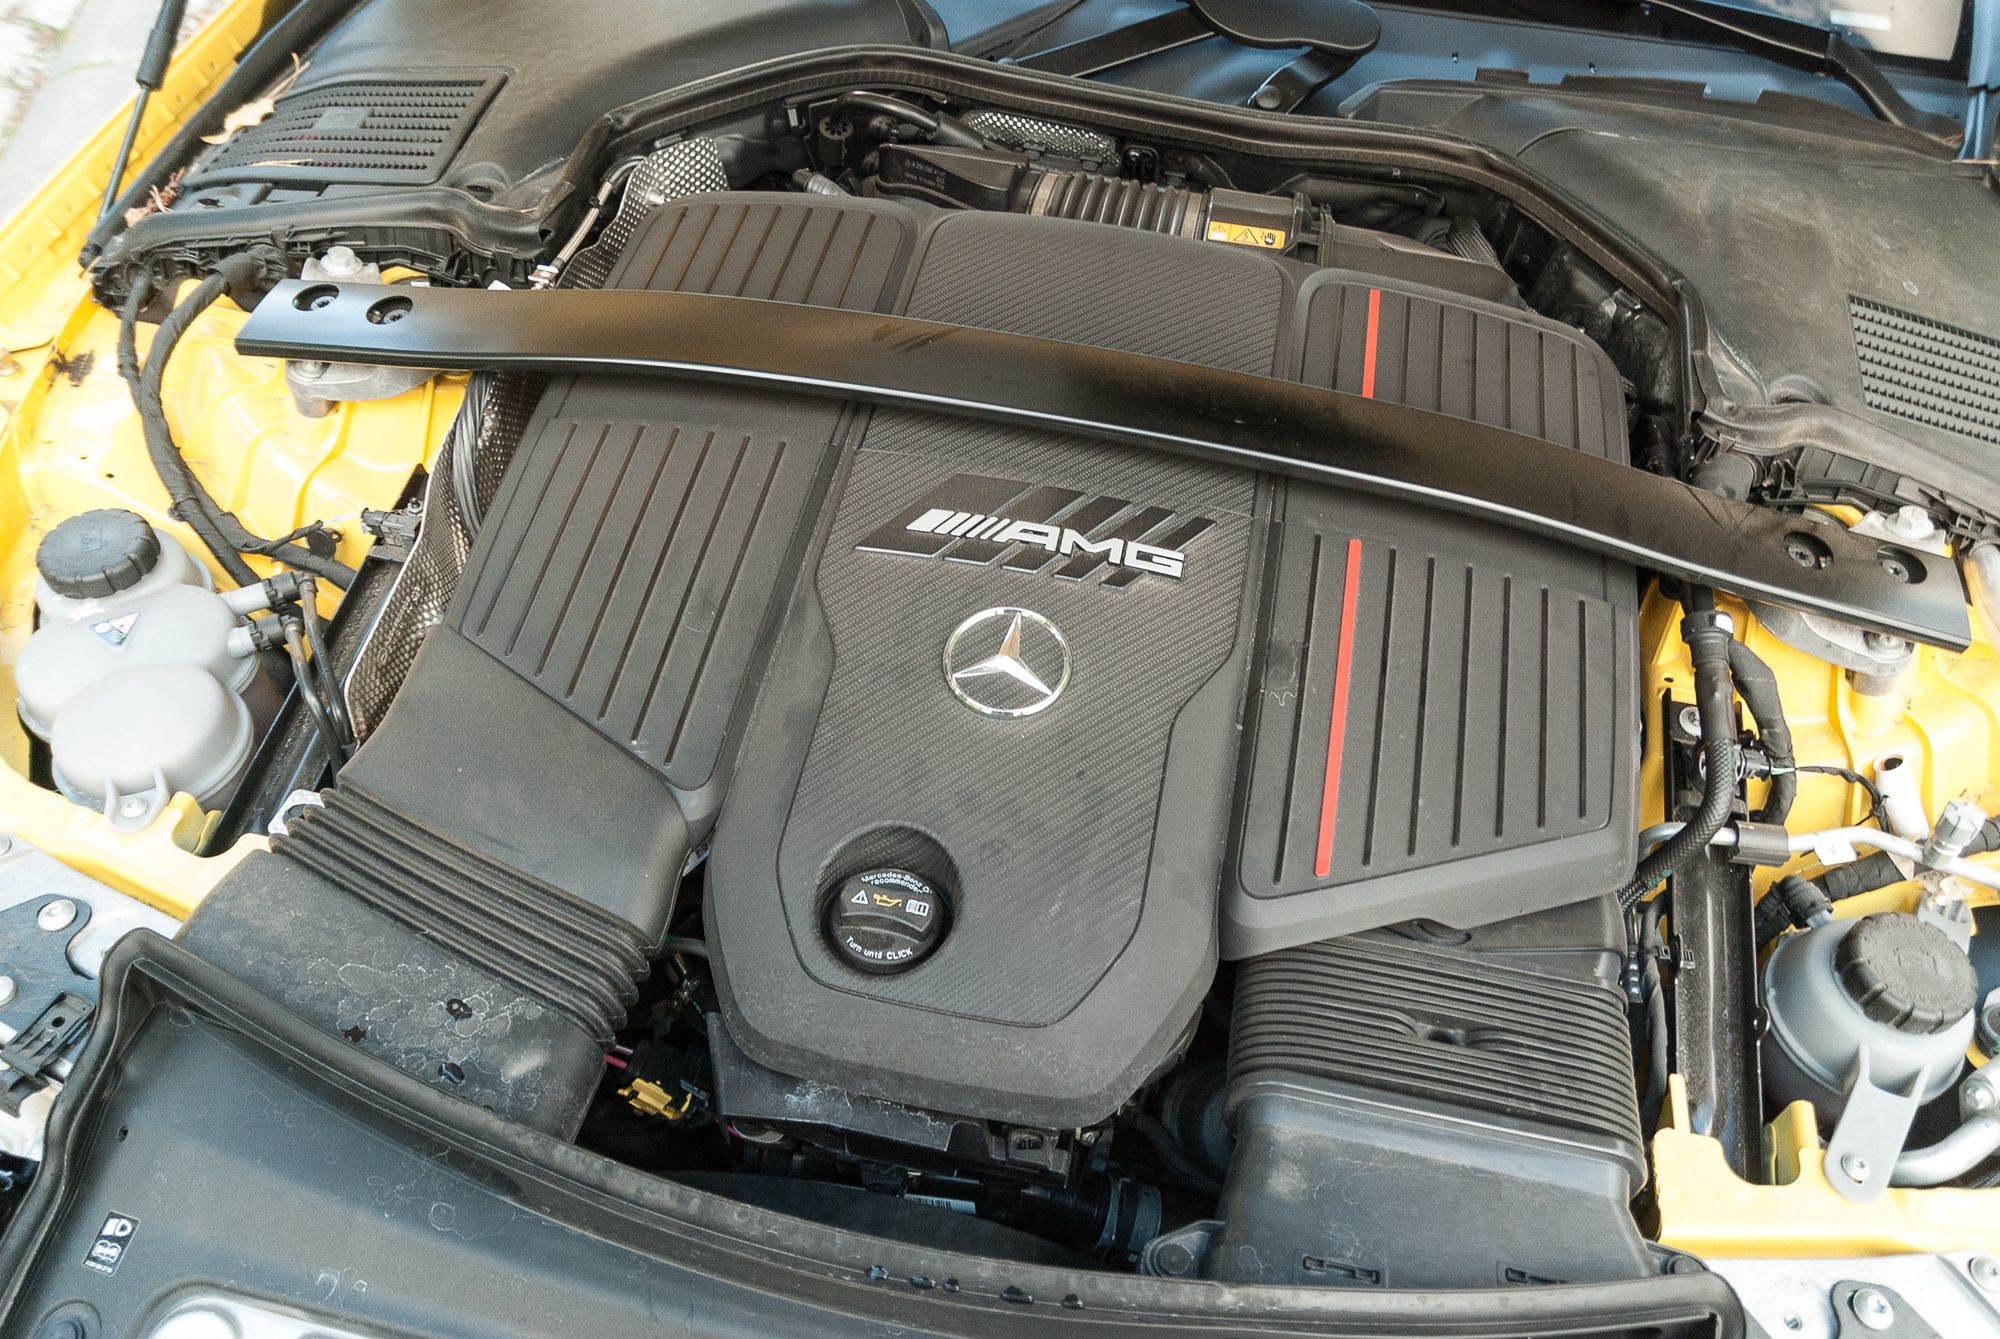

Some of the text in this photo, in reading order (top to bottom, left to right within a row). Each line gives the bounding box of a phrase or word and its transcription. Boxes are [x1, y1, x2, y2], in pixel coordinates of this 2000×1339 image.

[993, 519, 1185, 578] AMG
[861, 872, 923, 887] Mercedes-Benz
[846, 936, 913, 960] Turn until CLICK
